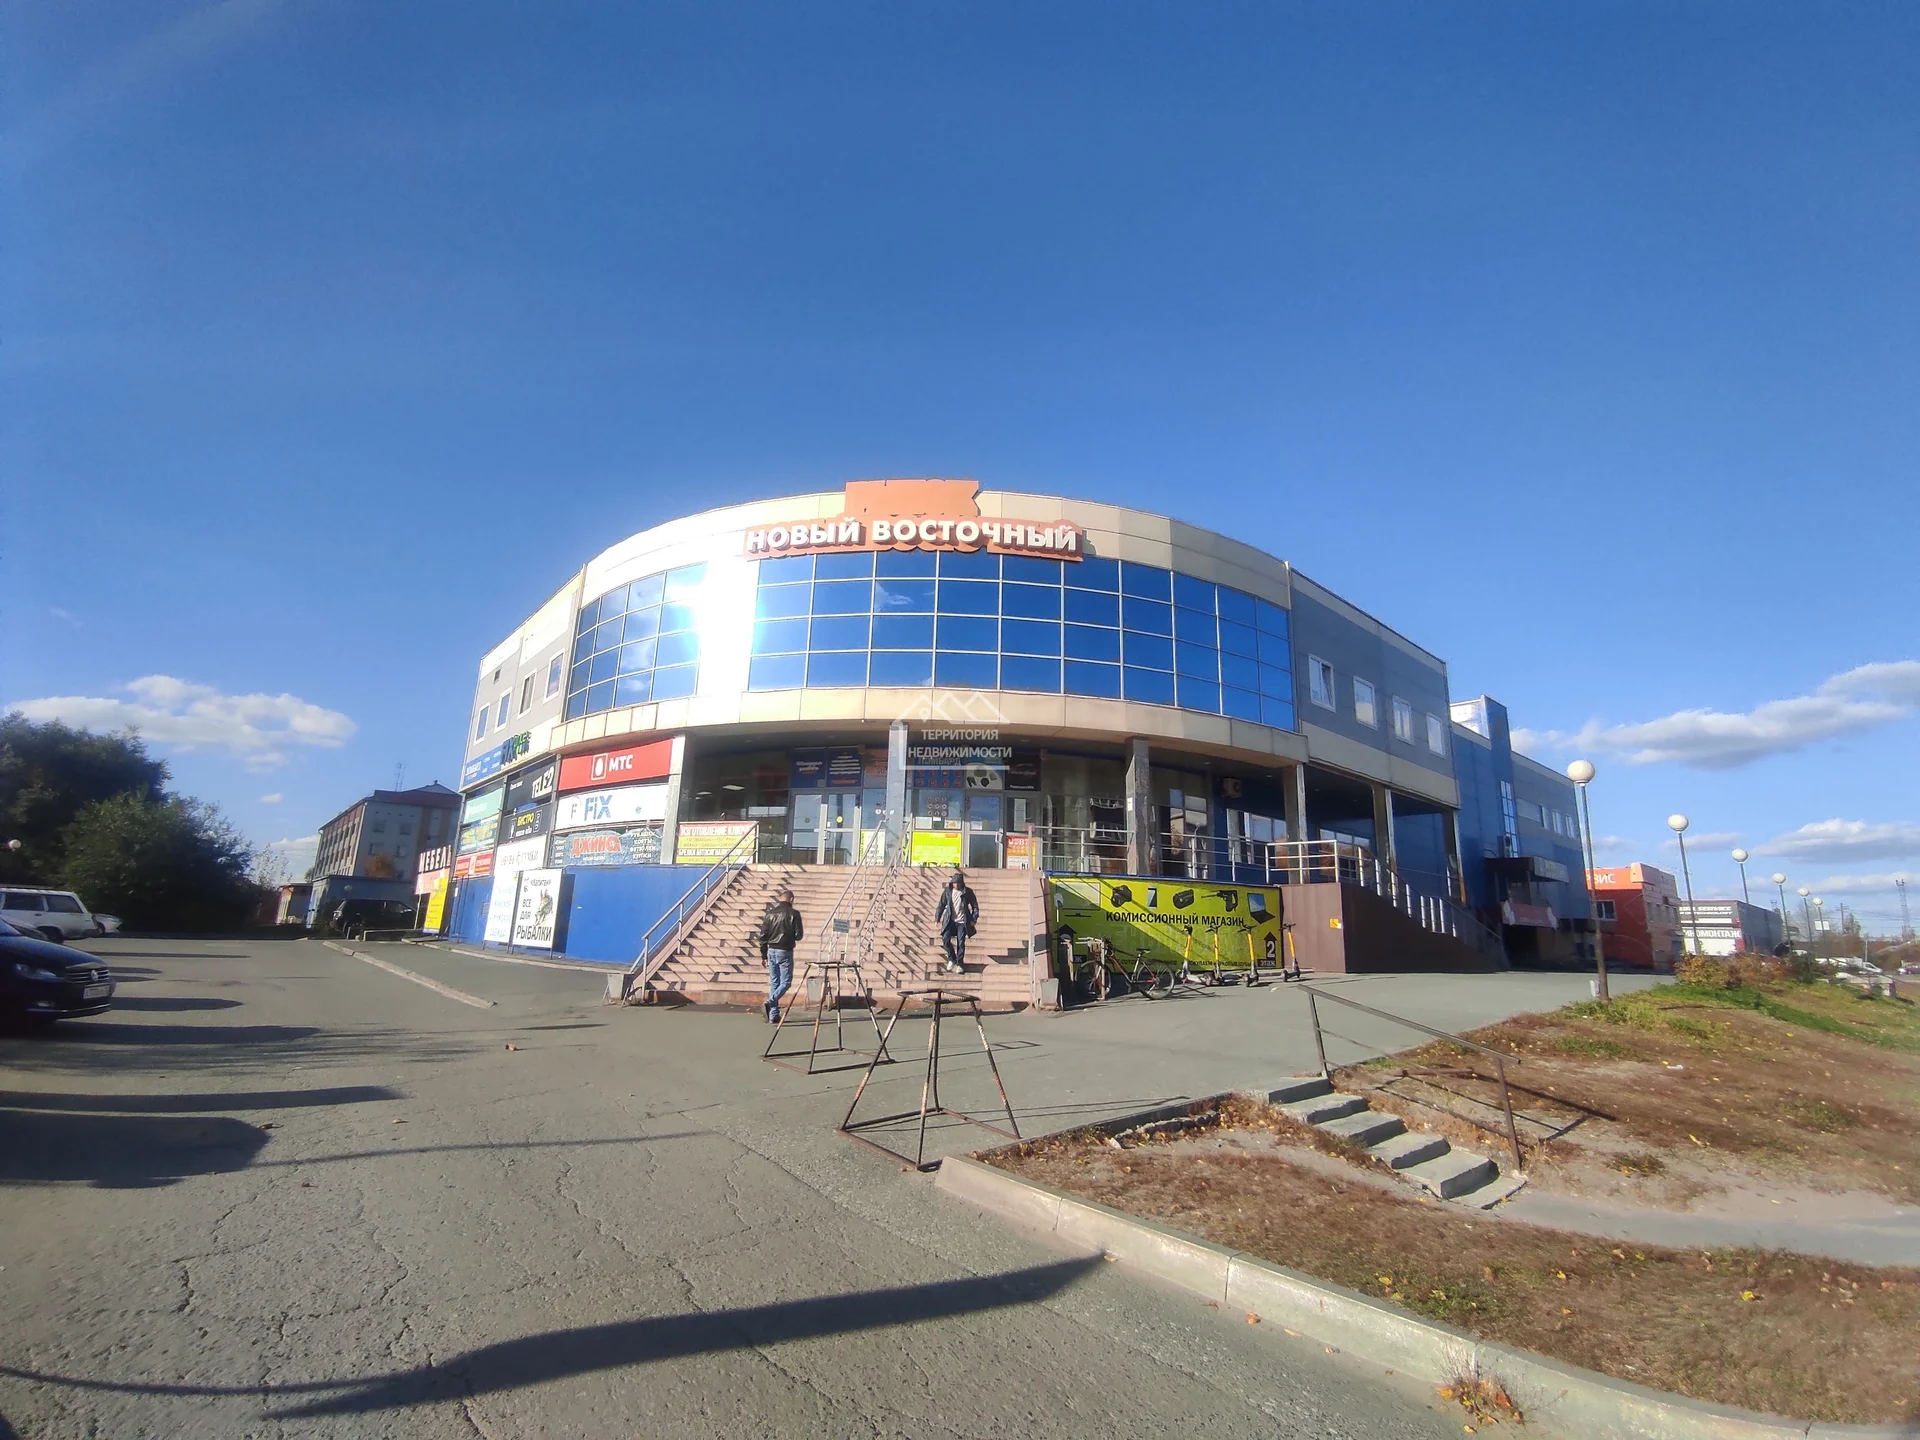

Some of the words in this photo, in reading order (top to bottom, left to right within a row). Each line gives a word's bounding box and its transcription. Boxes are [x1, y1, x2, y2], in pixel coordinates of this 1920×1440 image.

[748, 517, 860, 551] НОВЫЙ
[872, 519, 1077, 551] ВОСТОЧНЫЙ
[608, 754, 634, 772] МТС
[1106, 911, 1199, 925] КОМИССИОННЫЙ
[1201, 914, 1245, 927] МАГАЗИН
[515, 925, 553, 941] РЫБАЛКИ
[1266, 940, 1276, 958] 2
